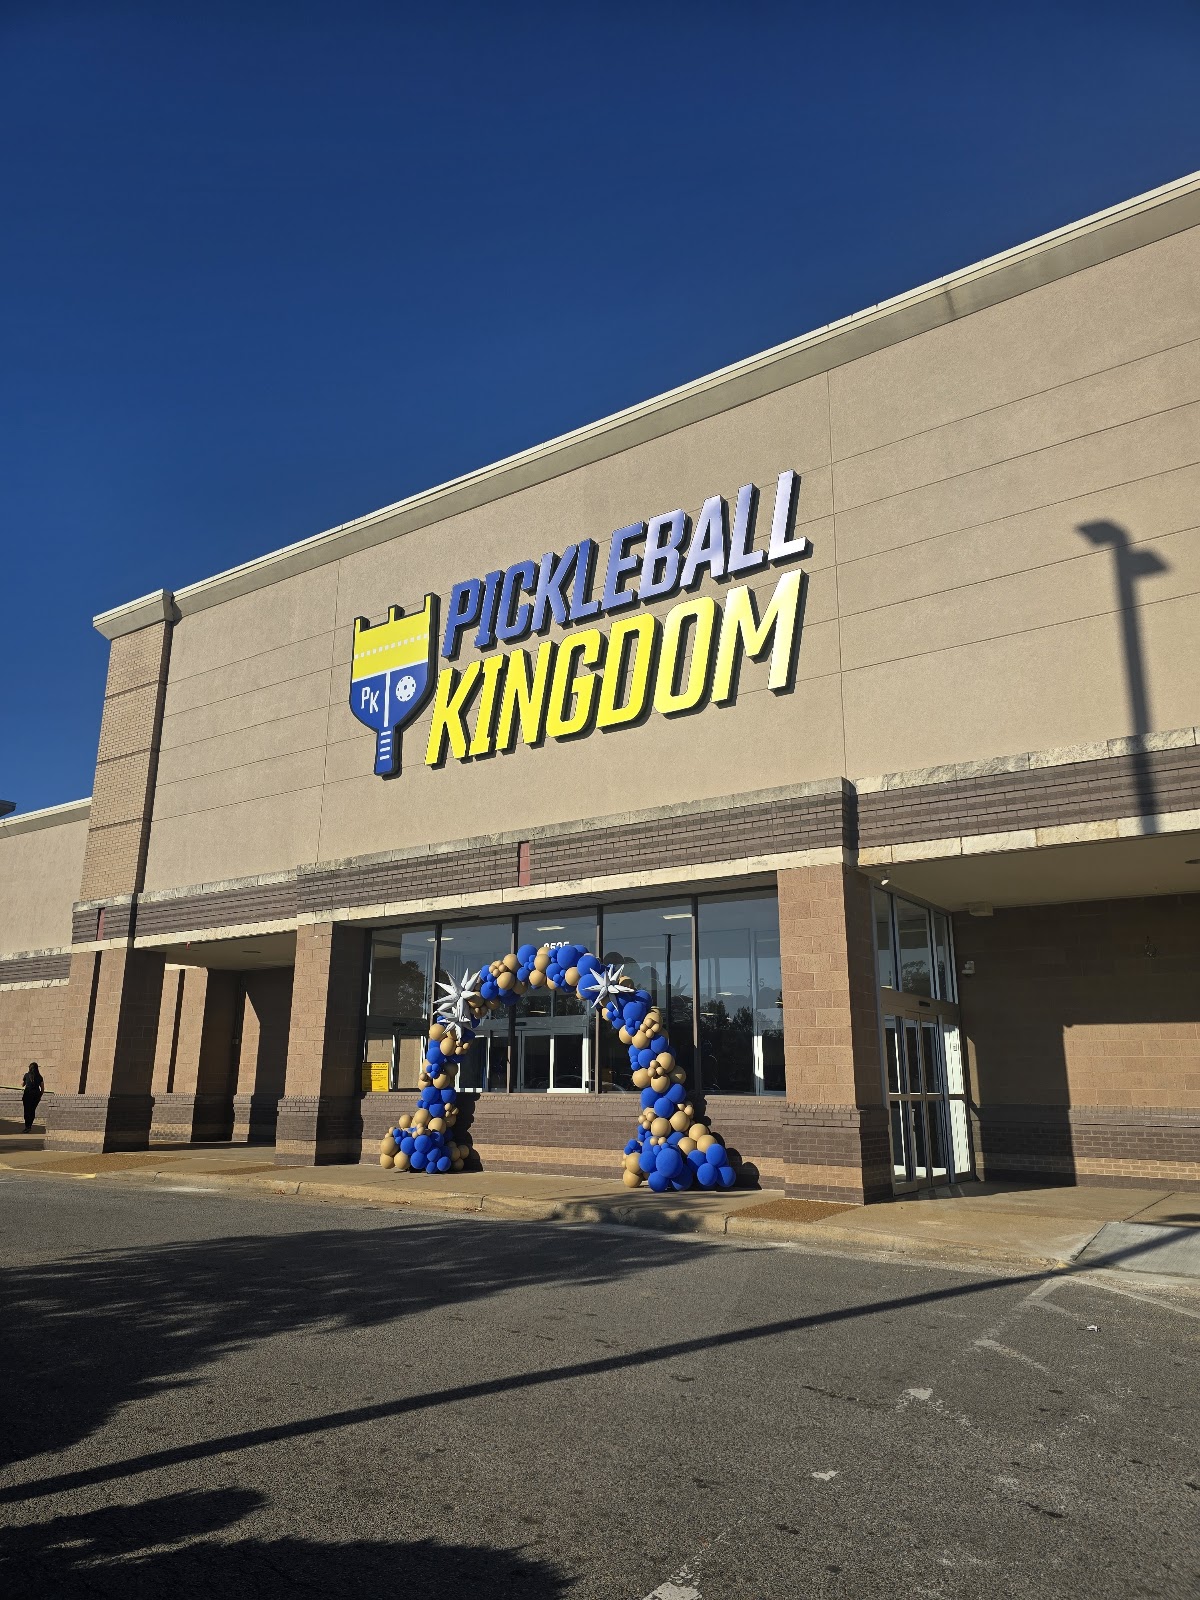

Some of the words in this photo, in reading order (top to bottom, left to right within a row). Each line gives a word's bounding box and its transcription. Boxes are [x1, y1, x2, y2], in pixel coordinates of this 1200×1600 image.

[441, 469, 808, 658] PICKLEBALL
[361, 686, 380, 714] PK
[425, 568, 805, 767] KINGDOM
